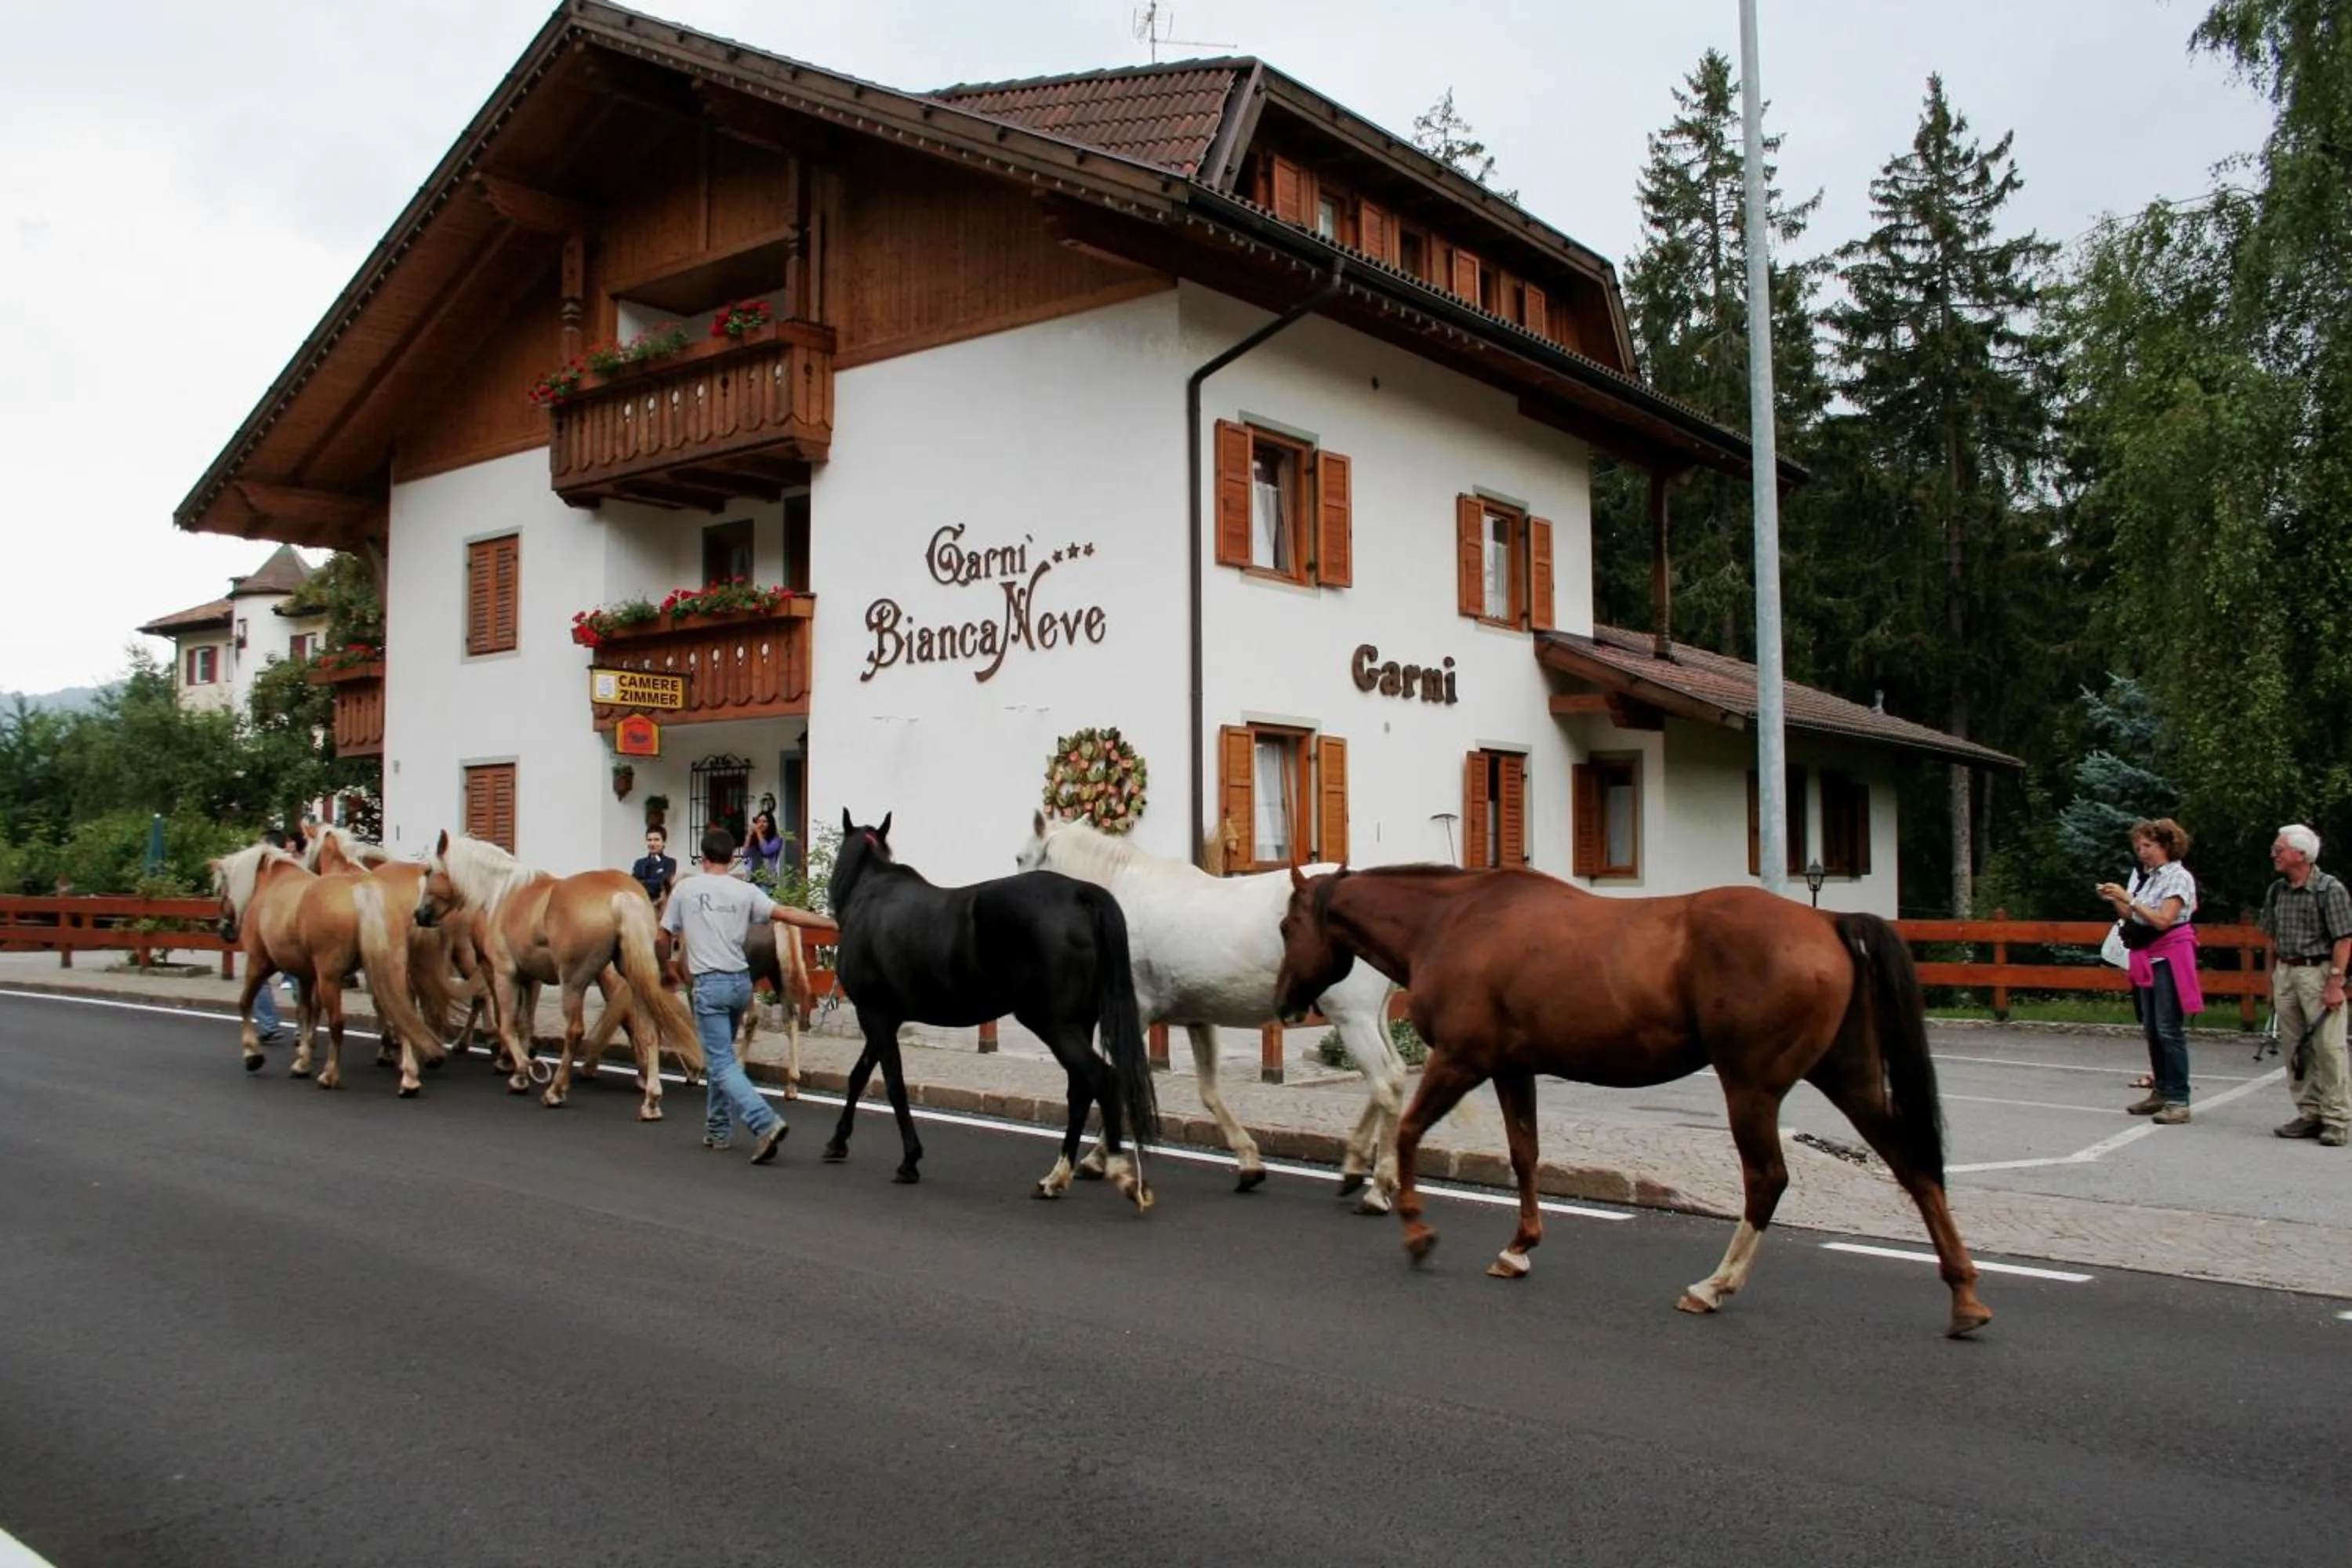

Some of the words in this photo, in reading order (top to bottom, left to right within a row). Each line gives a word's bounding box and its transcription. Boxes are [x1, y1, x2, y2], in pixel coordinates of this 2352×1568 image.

[1352, 644, 1458, 705] Garni
[618, 675, 679, 691] CAMERE
[619, 690, 678, 706] ZIMMER
